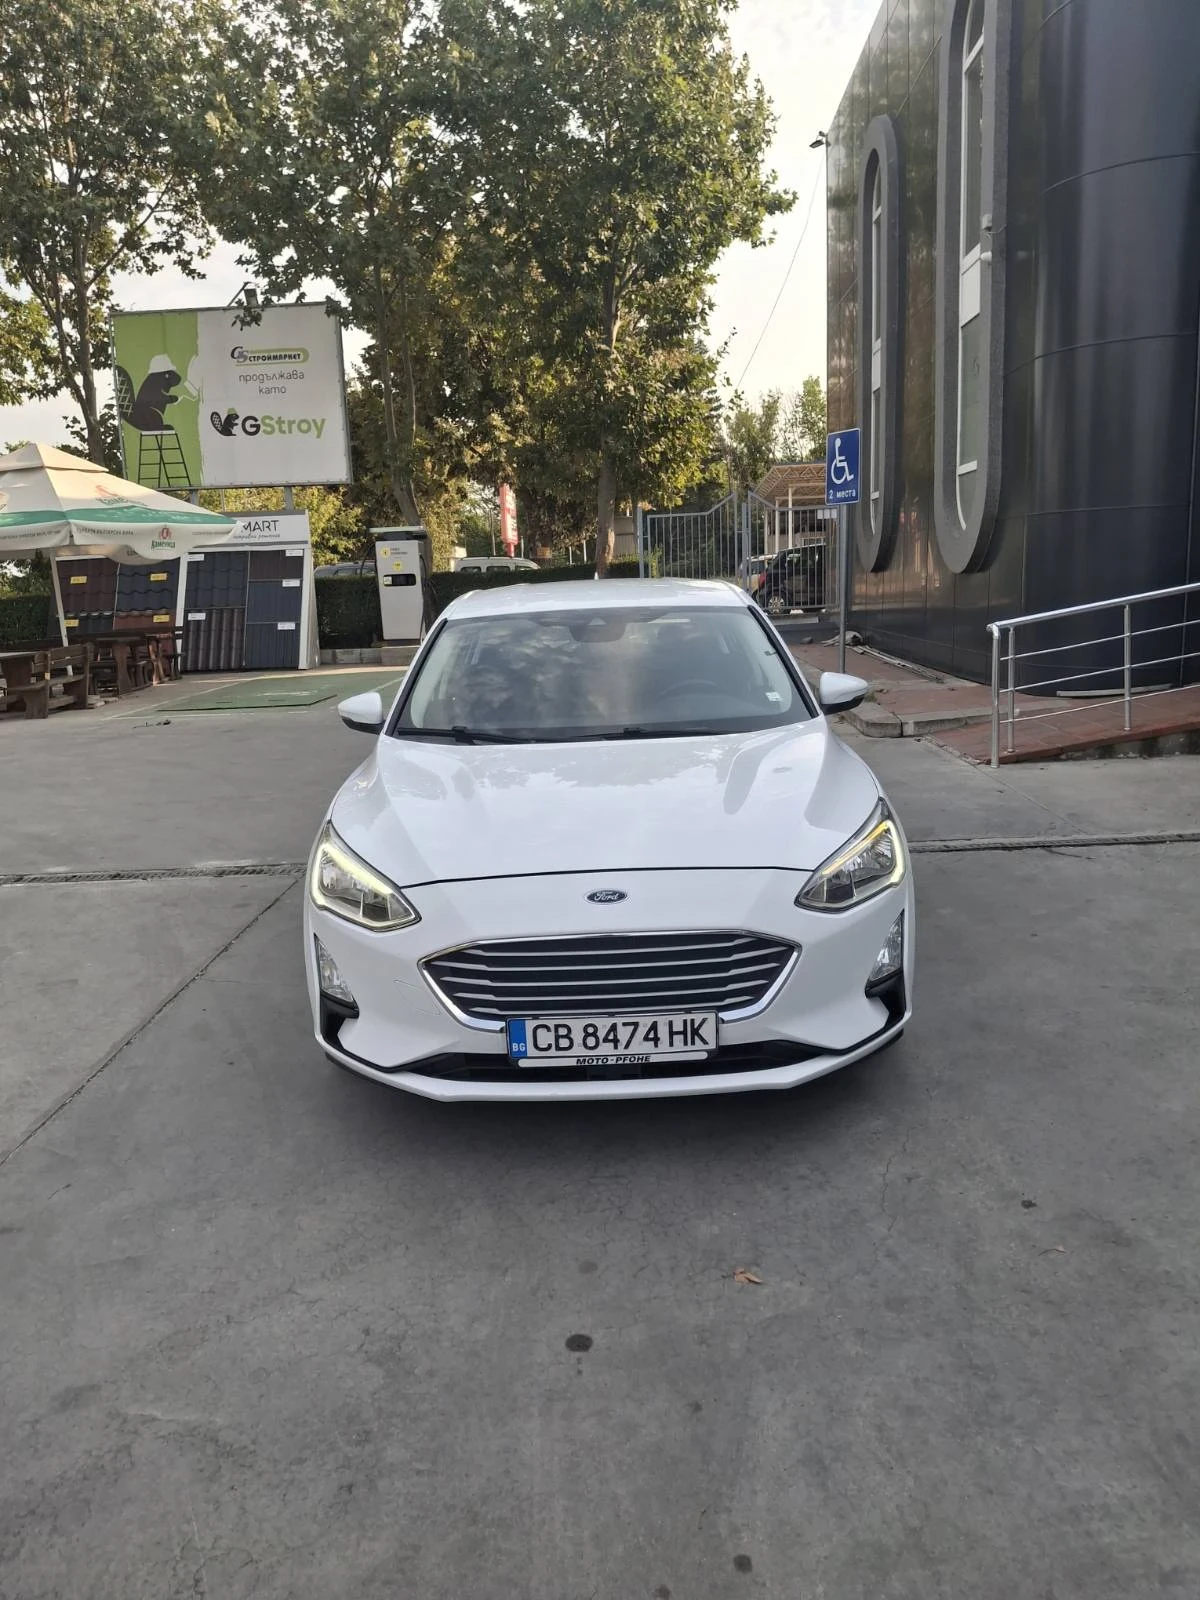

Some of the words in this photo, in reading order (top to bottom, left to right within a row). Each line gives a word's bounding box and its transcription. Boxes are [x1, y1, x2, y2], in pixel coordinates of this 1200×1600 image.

[239, 369, 305, 384] продължава
[258, 386, 287, 395] като
[241, 414, 326, 439] GStroy
[829, 490, 834, 499] 2
[836, 489, 856, 499] места
[594, 891, 619, 901] Ford
[582, 1020, 661, 1051] 8474
[512, 1042, 526, 1052] BG
[575, 1055, 651, 1066] MOTO-PFOHE
